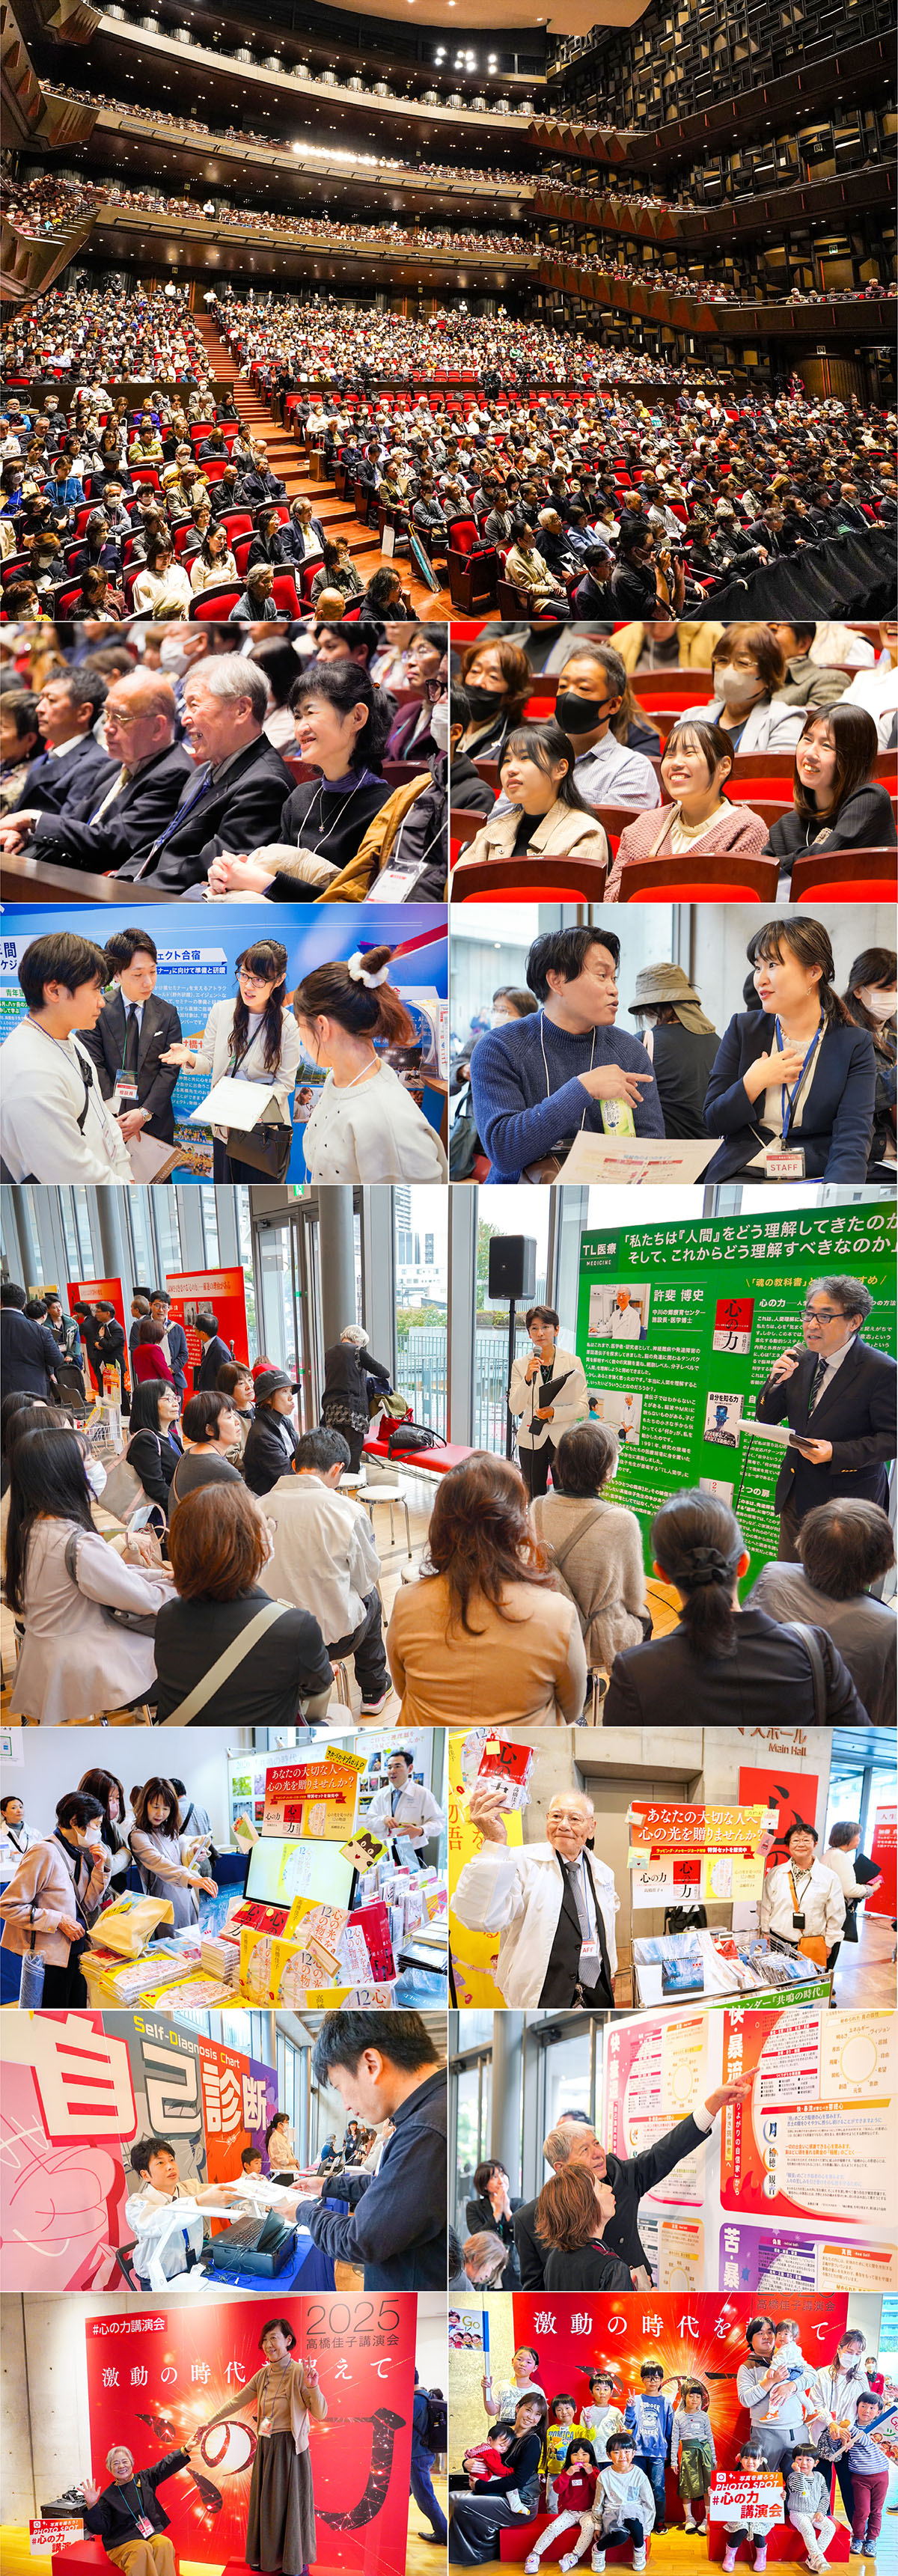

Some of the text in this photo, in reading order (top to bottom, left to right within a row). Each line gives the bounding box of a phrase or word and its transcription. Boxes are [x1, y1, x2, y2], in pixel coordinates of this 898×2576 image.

[624, 1212, 897, 1248] 「私たちは『人間』をどう理解してきたのか
[583, 1243, 617, 1257] TL医療
[721, 1299, 742, 1351] 心の力
[709, 1394, 739, 1403] 自分を知る力
[769, 1743, 807, 1756] Main Hall
[272, 1764, 349, 1780] あなたの大切な人へ
[266, 1777, 354, 1792] 心の光を贈りませんか?
[287, 1804, 297, 1833] 心の力
[647, 1808, 758, 1826] あなたの大切な人へ
[638, 1826, 763, 1842] 心の光を贈りませんか?
[640, 1873, 667, 1883] 心の力
[680, 1861, 692, 1899] 心の力
[133, 2015, 240, 2069] Self-Diagnosis Chart
[32, 2013, 268, 2137] 自己診断
[769, 2122, 778, 2137] 月
[756, 2299, 836, 2313] 高橋佳子講演会
[306, 2299, 401, 2337] 2025
[462, 2316, 480, 2330] Go
[92, 2317, 165, 2337] #心の力講演会
[306, 2334, 400, 2351] 高橋佳子講演会
[739, 2473, 778, 2482] 写真を撮ろう!
[715, 2481, 779, 2491] PHOTO SPOT
[712, 2491, 760, 2506] #心の力
[740, 2503, 783, 2519] 講演会
[33, 2524, 79, 2535] PHOTO SPOT
[31, 2533, 65, 2545] #心の力
